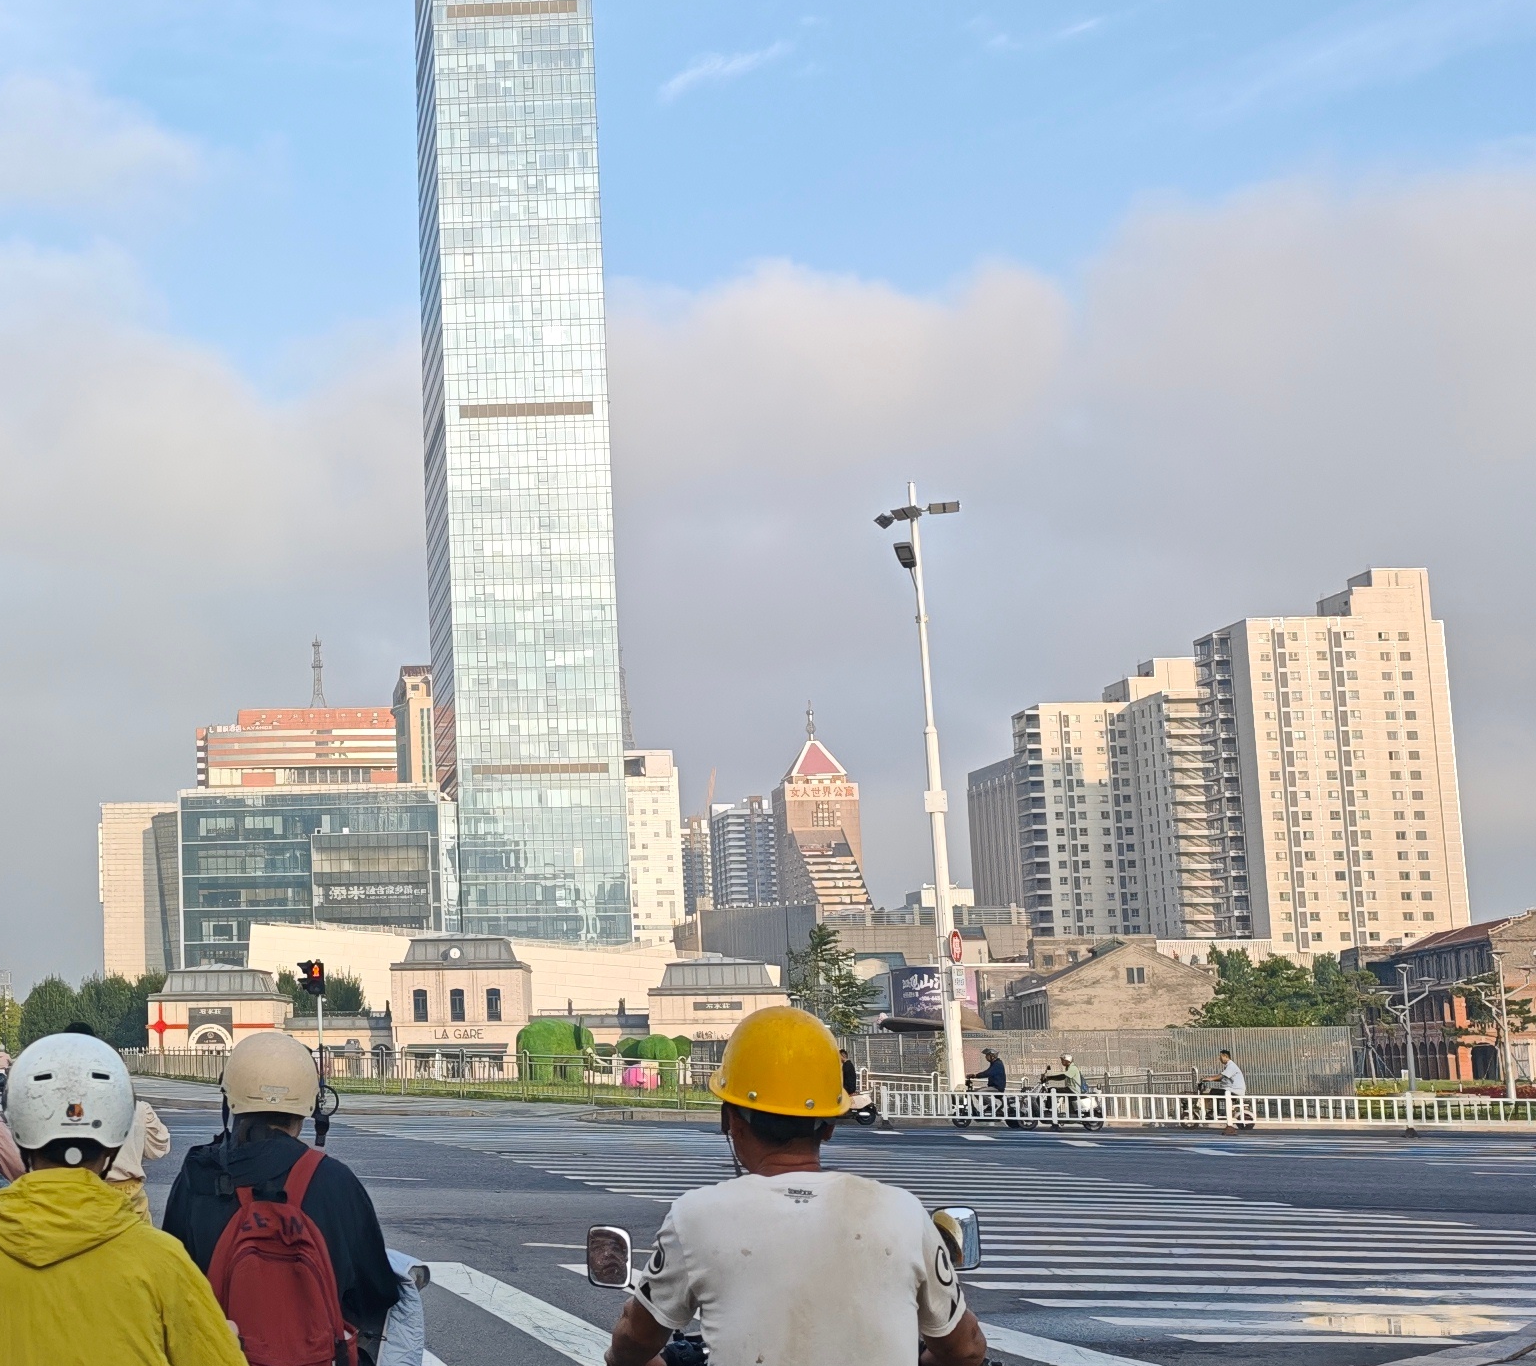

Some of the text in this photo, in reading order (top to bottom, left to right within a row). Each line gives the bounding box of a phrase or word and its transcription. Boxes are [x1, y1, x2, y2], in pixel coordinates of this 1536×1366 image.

[789, 786, 855, 798] 女人世界公寓
[434, 1028, 484, 1040] LA GARE
